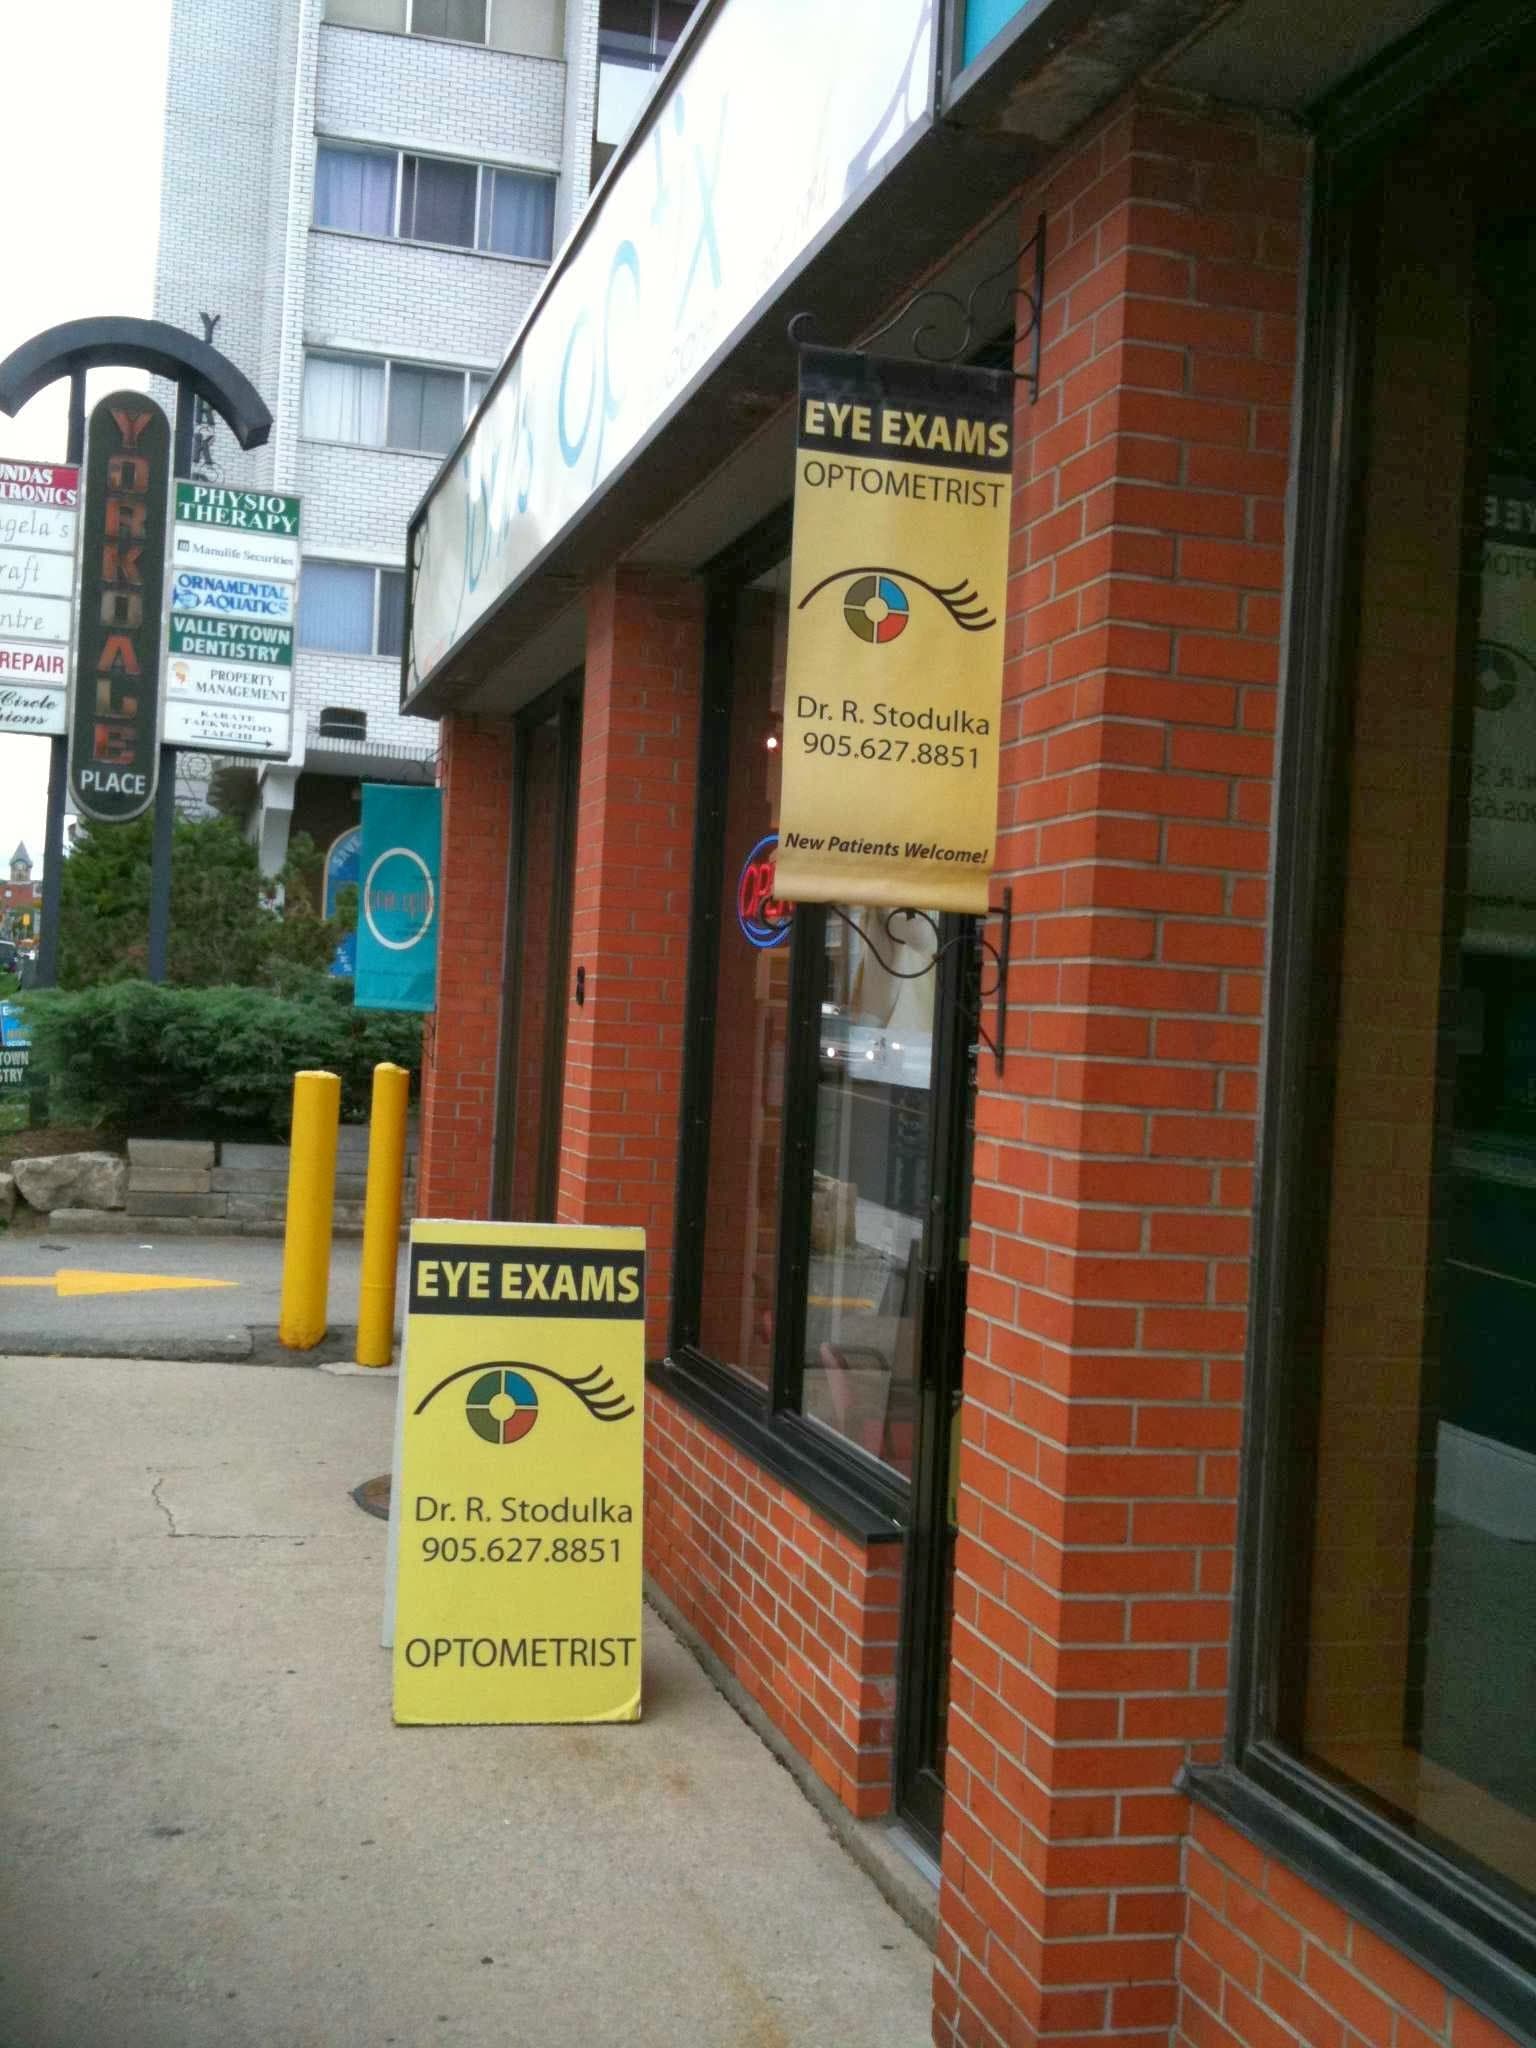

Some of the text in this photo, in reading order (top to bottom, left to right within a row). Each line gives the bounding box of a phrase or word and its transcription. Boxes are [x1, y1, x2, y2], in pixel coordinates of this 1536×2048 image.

[804, 399, 1009, 458] EYE EXAMS
[803, 460, 1005, 508] OPTOMETRIST
[193, 486, 286, 514] PHYSIO
[179, 502, 297, 533] THERAPY
[92, 407, 154, 766] YORKDALE
[178, 573, 289, 601] ORNAMENTAL
[203, 593, 289, 615] AQUATICS
[173, 616, 291, 646] VALLEYTOWN
[0, 650, 65, 675] REPAIR
[181, 637, 280, 662] DENTISTRY
[196, 681, 288, 702] MANAGEMENT
[210, 669, 275, 687] PROPERTY
[796, 695, 990, 736] Dr. R. Stodulka
[802, 731, 978, 769] 905.627.8851
[80, 767, 147, 796] PLACE
[784, 832, 990, 865] New Patients Welcome!
[416, 1259, 641, 1304] EYE EXAMS
[415, 1496, 634, 1524] Dr. R. Stodulka
[421, 1536, 621, 1564] 905.627.8851
[404, 1637, 637, 1669] OPTOMETRIST
